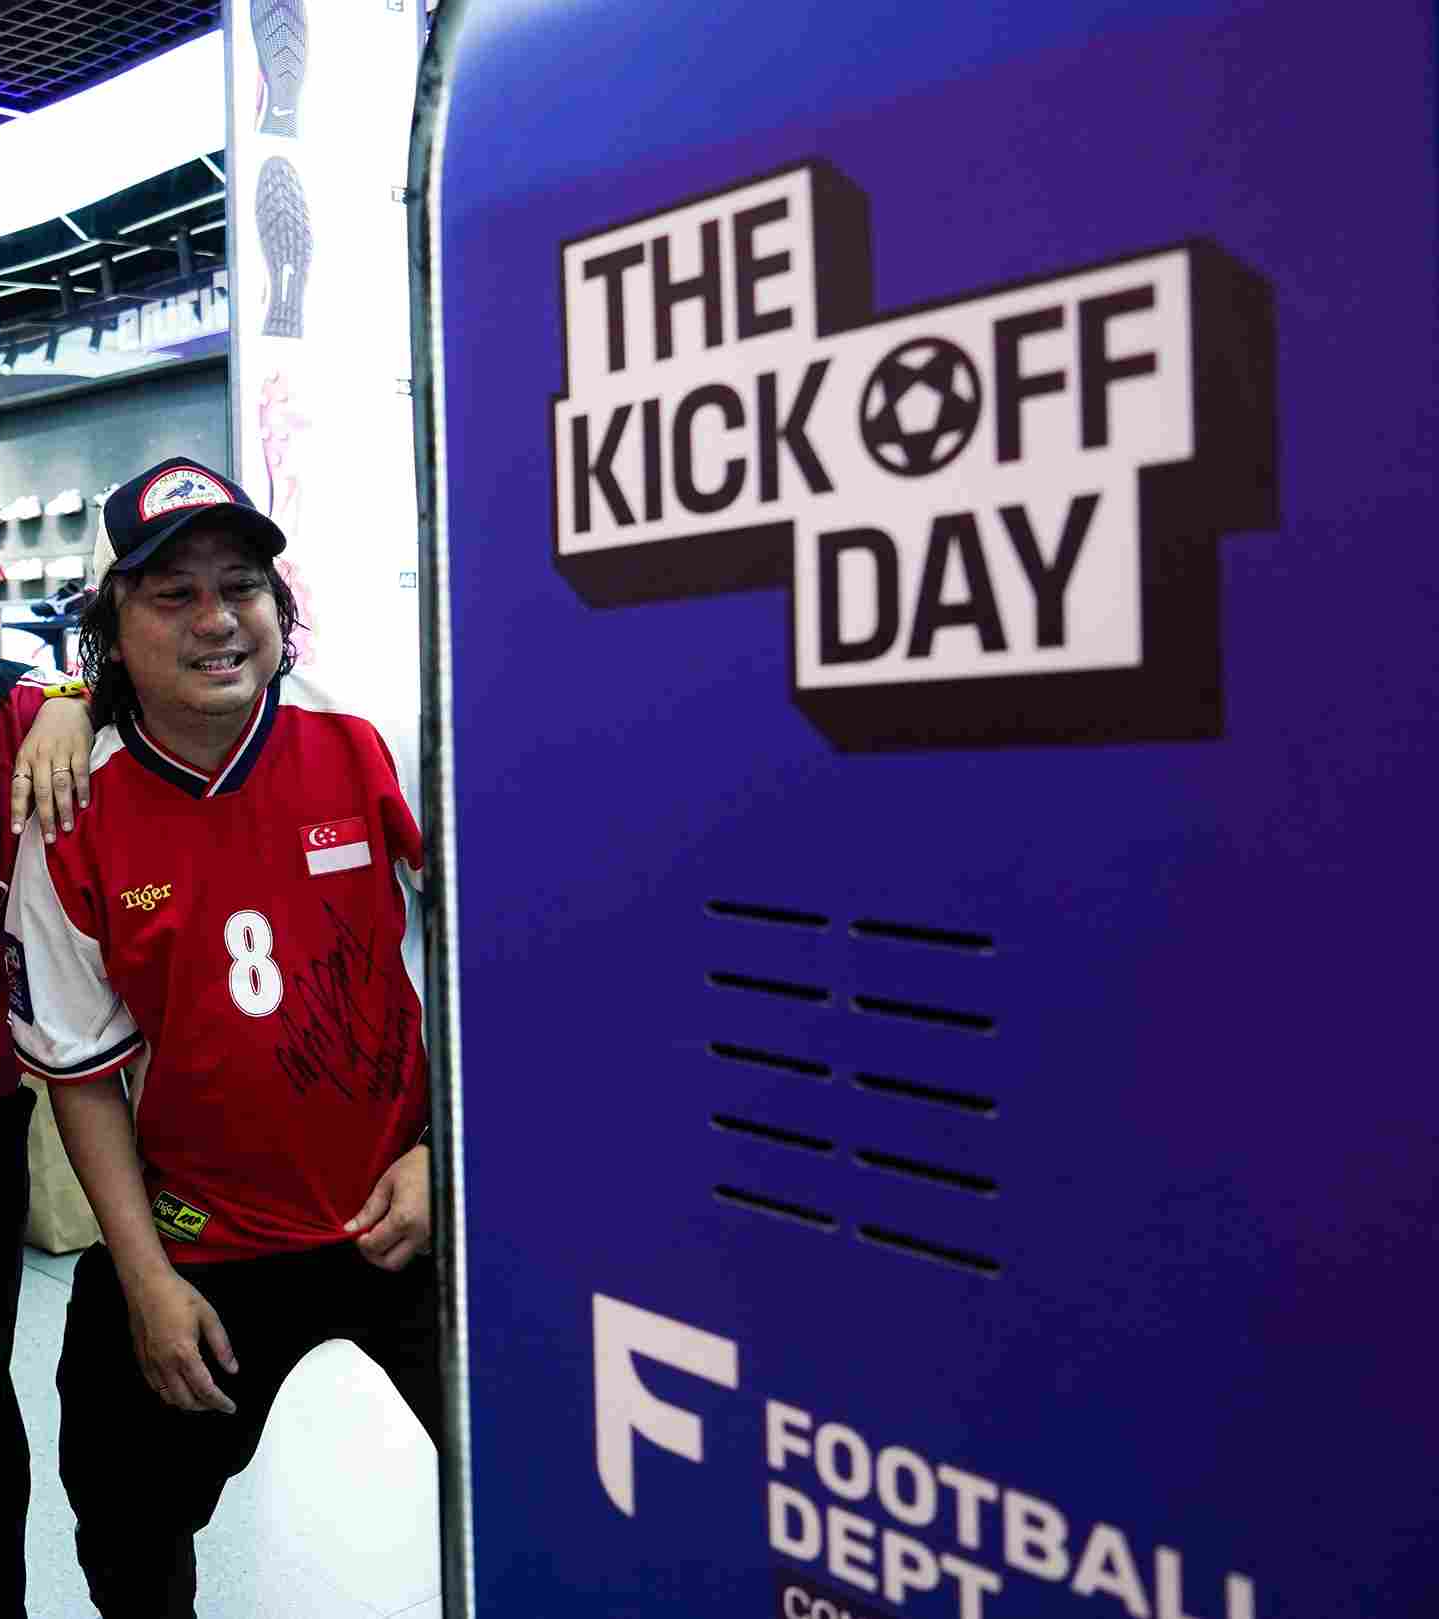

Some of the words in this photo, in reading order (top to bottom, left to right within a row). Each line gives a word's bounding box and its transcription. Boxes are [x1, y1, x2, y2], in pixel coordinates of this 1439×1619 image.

[582, 198, 794, 373] THE
[571, 360, 835, 534] KICK
[818, 492, 1100, 667] DAY
[121, 883, 172, 911] Tiger
[223, 909, 284, 1018] 8
[768, 1480, 1003, 1619] DEPT
